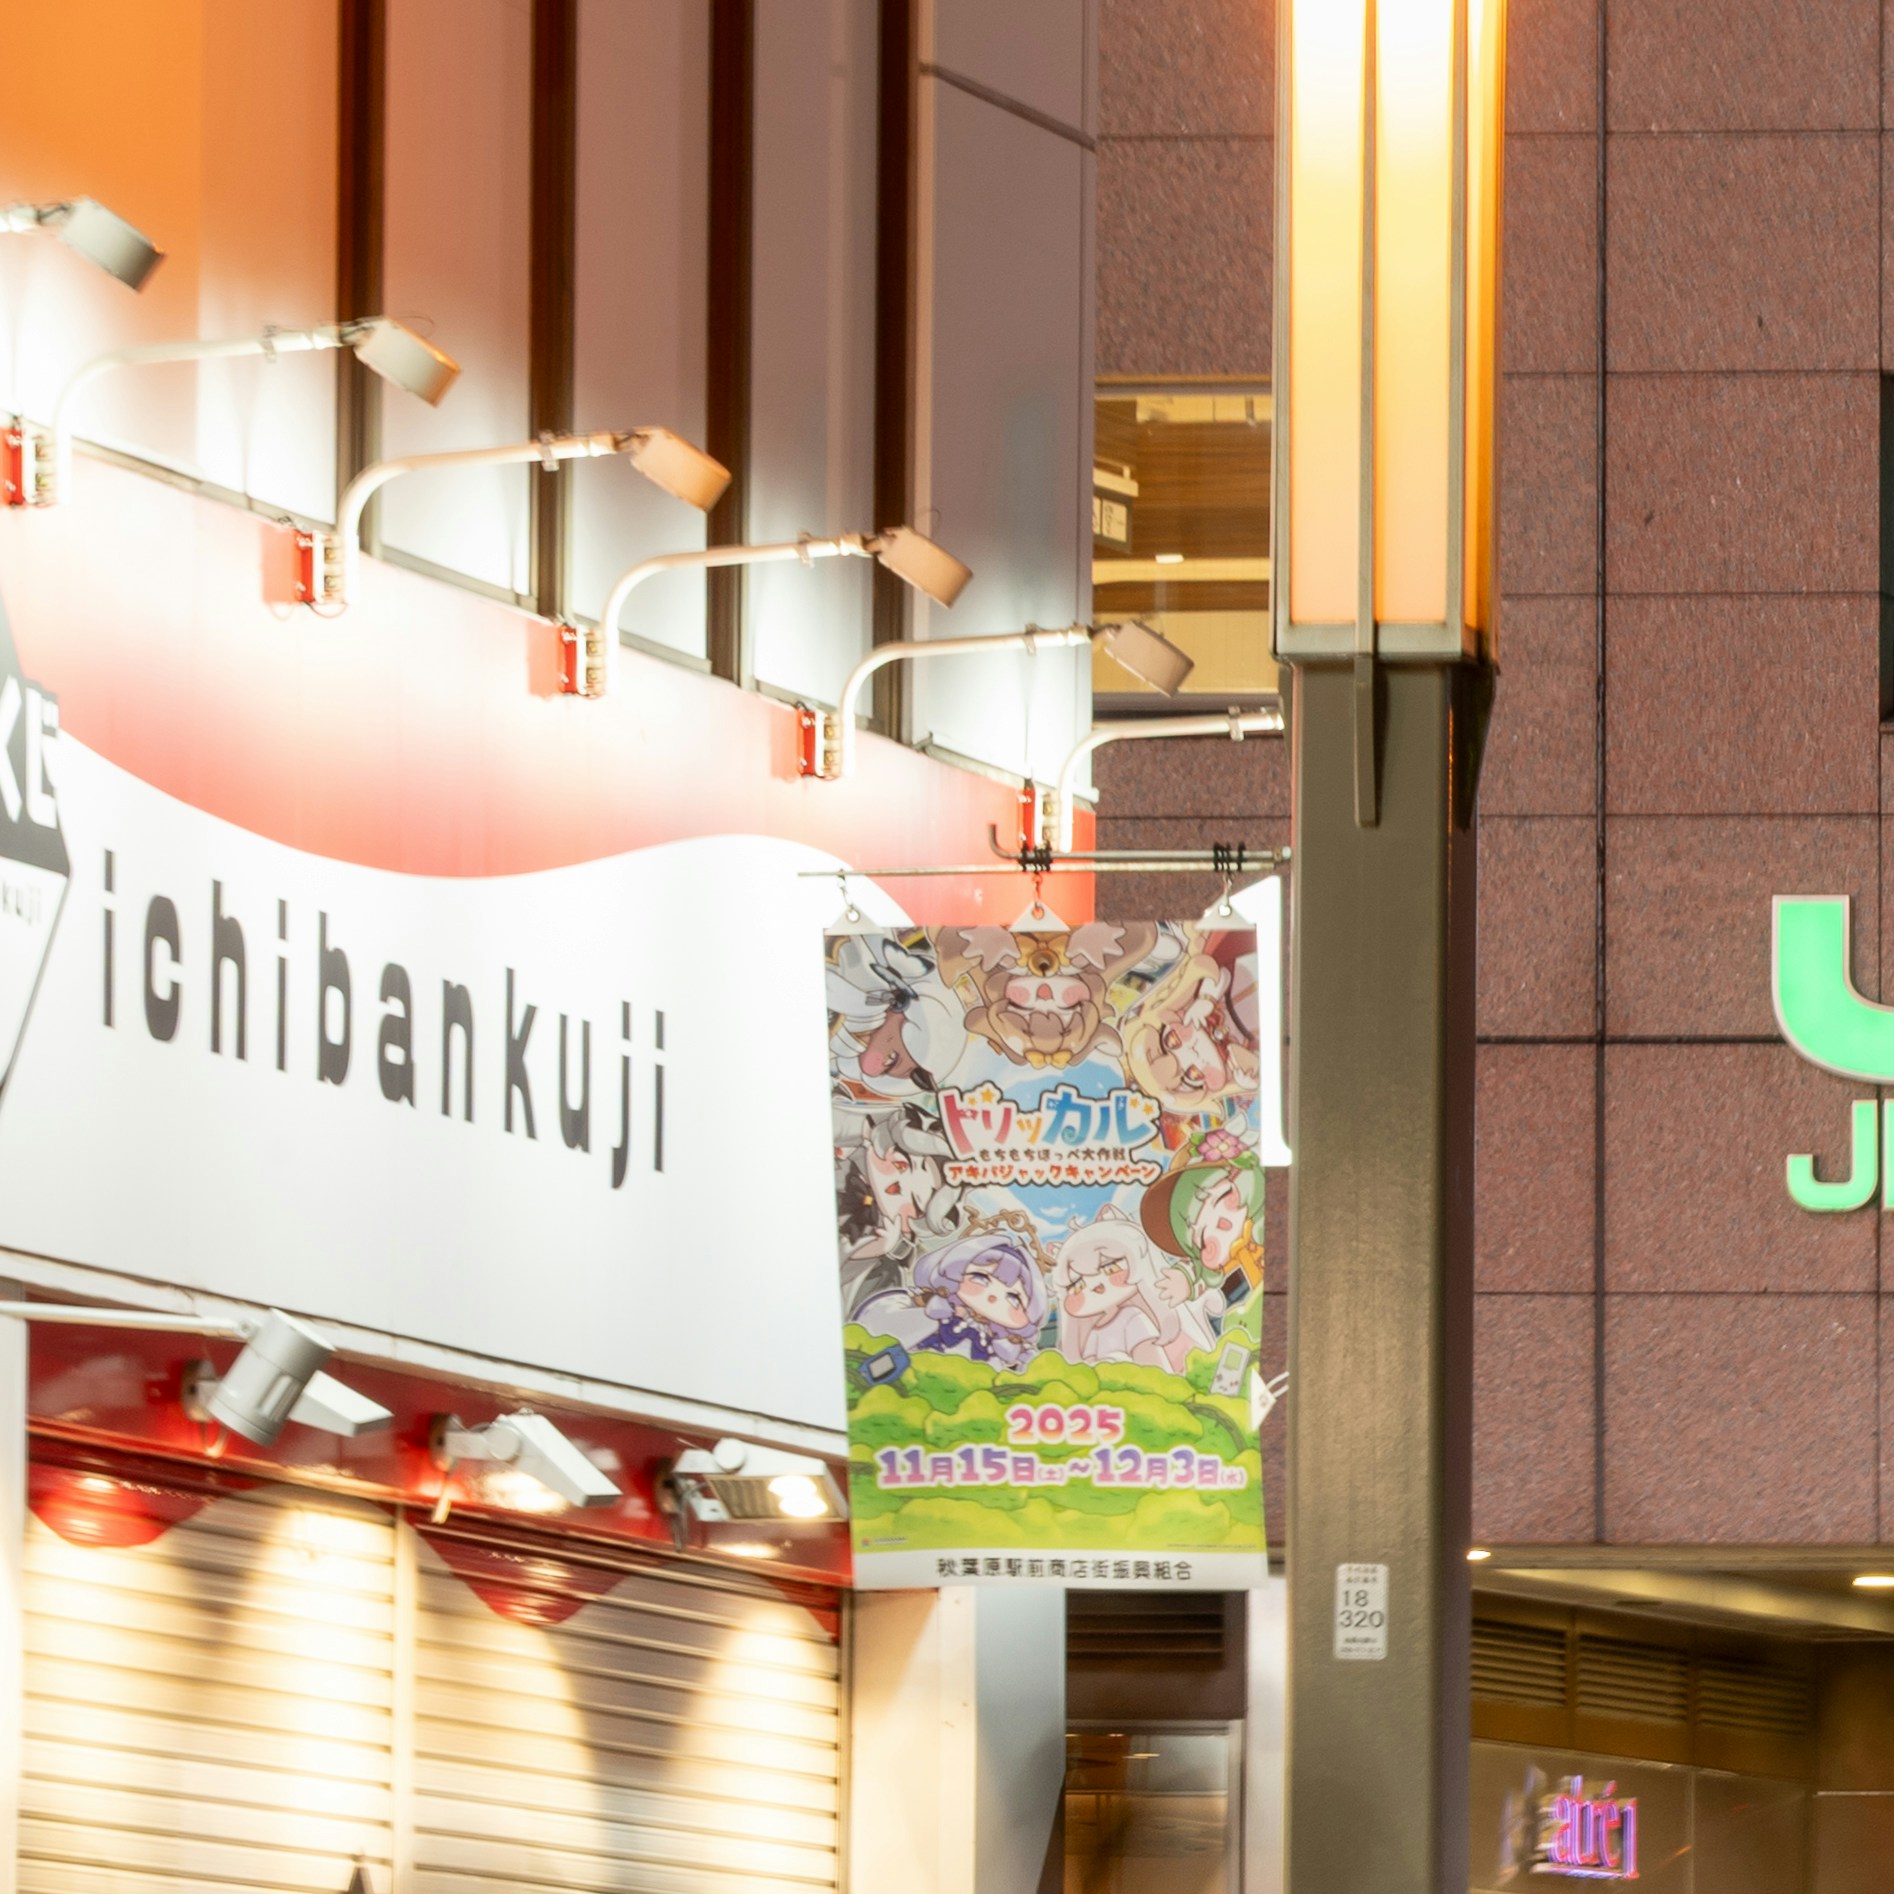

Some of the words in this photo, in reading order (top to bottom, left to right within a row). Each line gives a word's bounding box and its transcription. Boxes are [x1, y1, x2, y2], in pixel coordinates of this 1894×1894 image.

[102, 848, 667, 1190] ichibankuji
[948, 1164, 1157, 1184] アキバジャックキャンペーン
[1008, 1407, 1124, 1442] 2025
[937, 1557, 1193, 1581] 秋葉原駅前商店街振興組合
[1343, 1590, 1369, 1607] 18
[1339, 1610, 1385, 1628] 320
